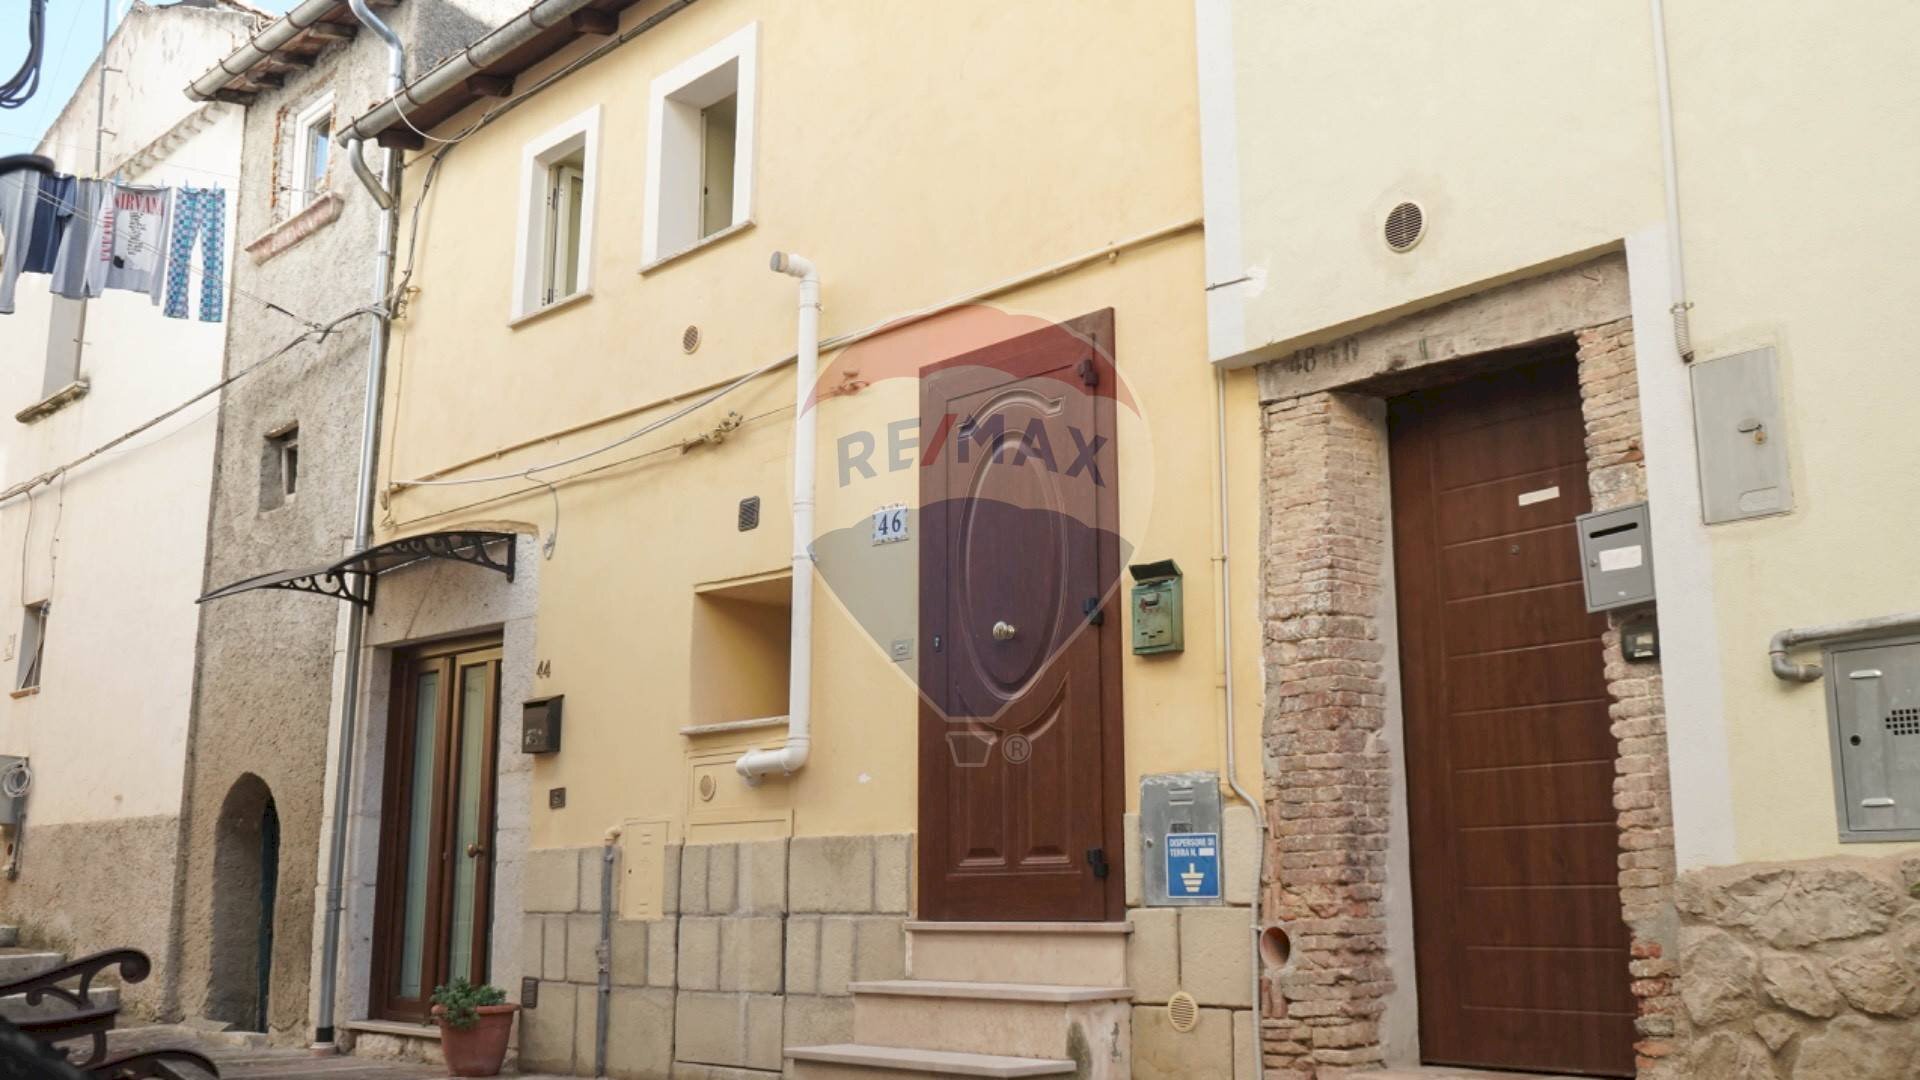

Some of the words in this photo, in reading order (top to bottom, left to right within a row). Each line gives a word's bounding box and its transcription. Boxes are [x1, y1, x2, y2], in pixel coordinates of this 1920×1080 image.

[878, 510, 902, 536] 46
[536, 660, 551, 679] 44
[1170, 847, 1190, 857] TERRA
